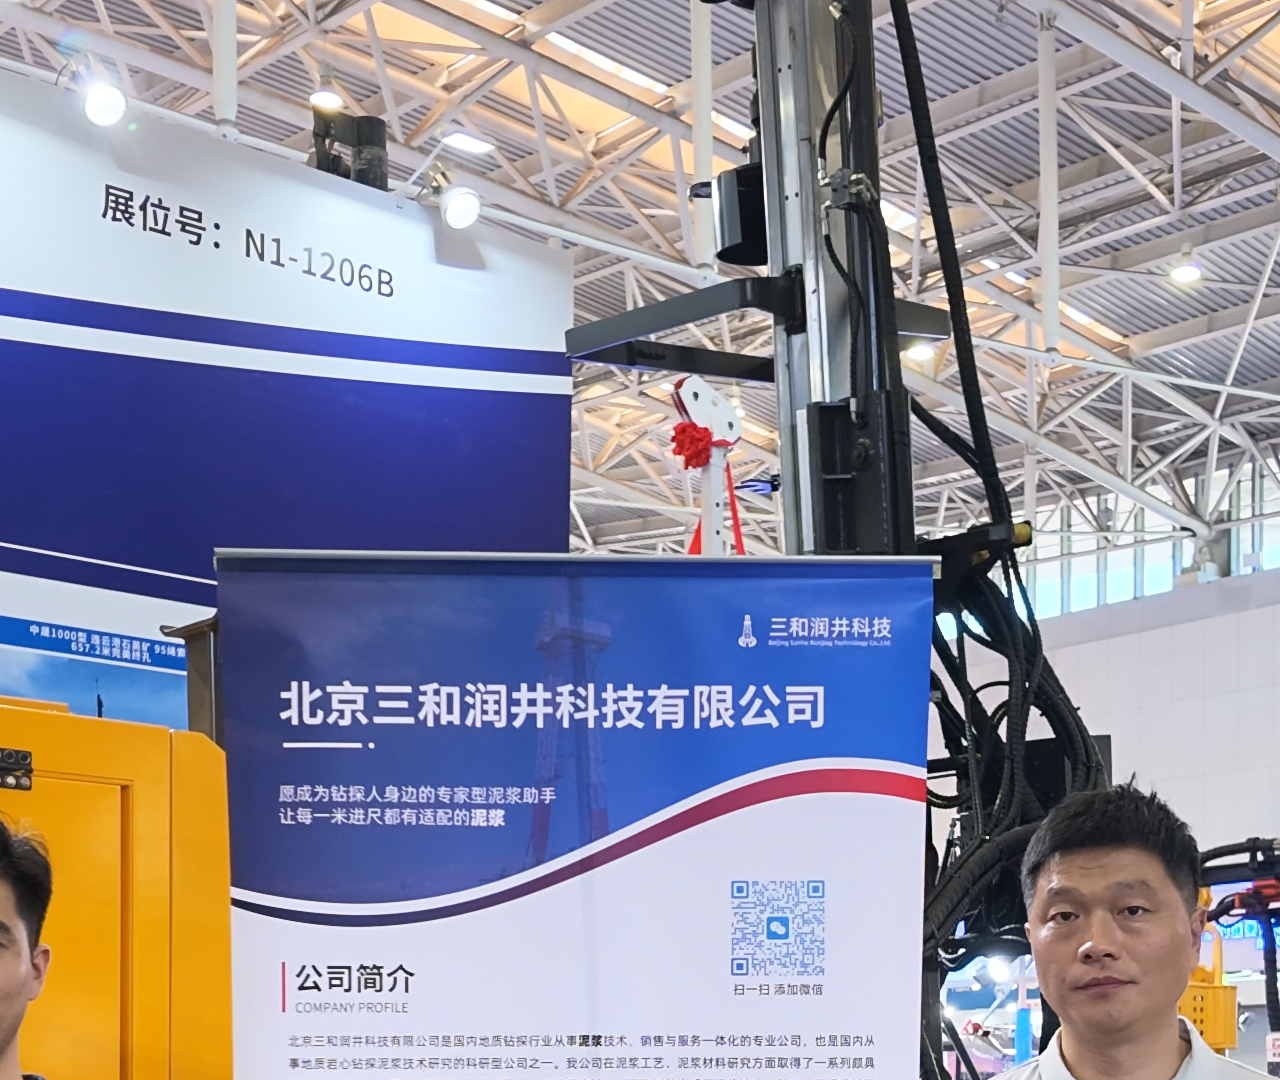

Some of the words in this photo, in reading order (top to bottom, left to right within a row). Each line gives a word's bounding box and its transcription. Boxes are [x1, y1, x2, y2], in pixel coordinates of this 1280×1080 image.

[245, 228, 395, 298] N1-1206B
[769, 616, 892, 638] 三和润井科技
[279, 680, 826, 730] 北京三和润井科技有限公司
[278, 785, 557, 805] 愿成为钻探人身边的专家型泥浆助手
[278, 807, 506, 827] 让每一米进尺都有适配的泥浆
[295, 964, 415, 993] 公司简介
[733, 983, 770, 996] 扫一扫
[774, 983, 824, 996] 添加微信
[295, 1002, 355, 1014] COMPANY
[358, 1002, 409, 1014] PROFILE
